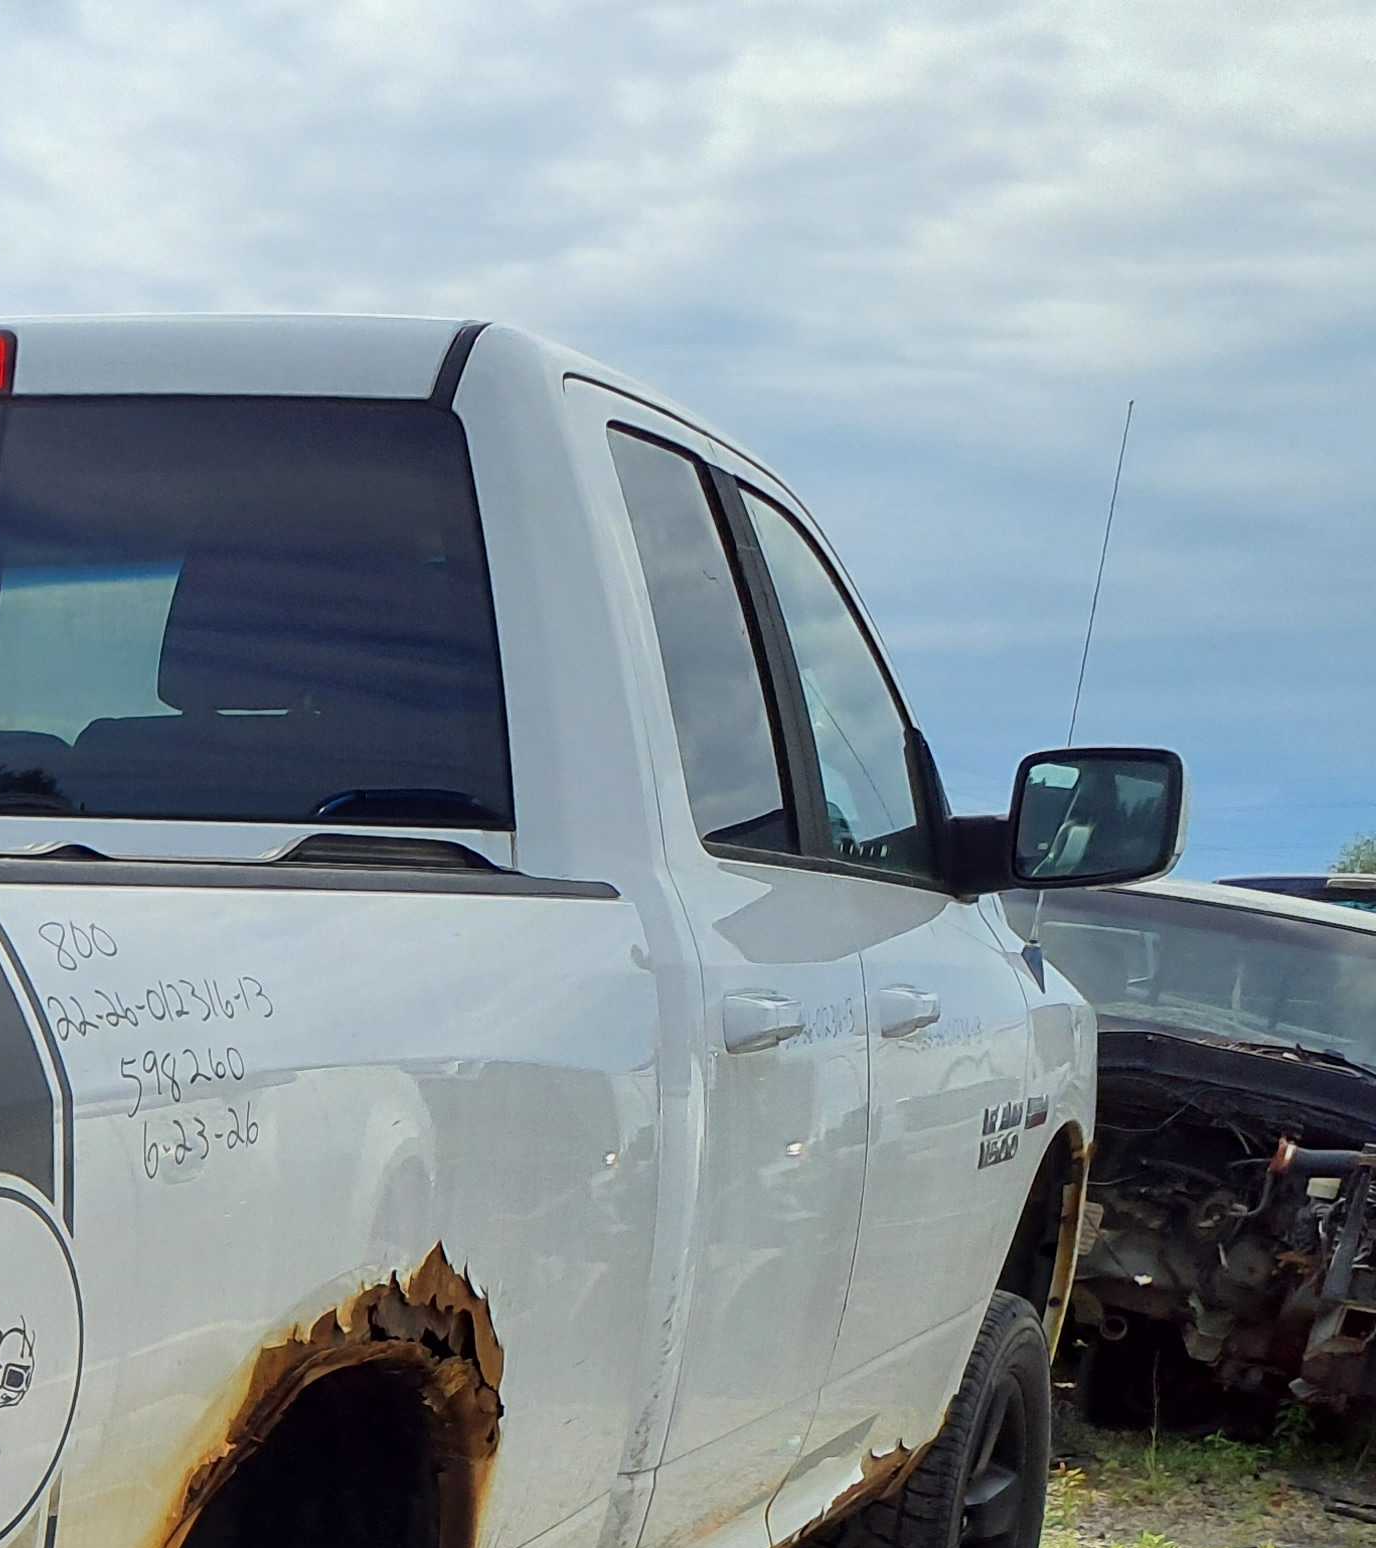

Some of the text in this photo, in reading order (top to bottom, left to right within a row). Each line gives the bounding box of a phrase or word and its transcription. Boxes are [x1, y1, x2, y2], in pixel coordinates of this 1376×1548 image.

[38, 921, 118, 971] 800
[120, 1047, 245, 1118] 598260
[978, 1132, 1019, 1170] 1500
